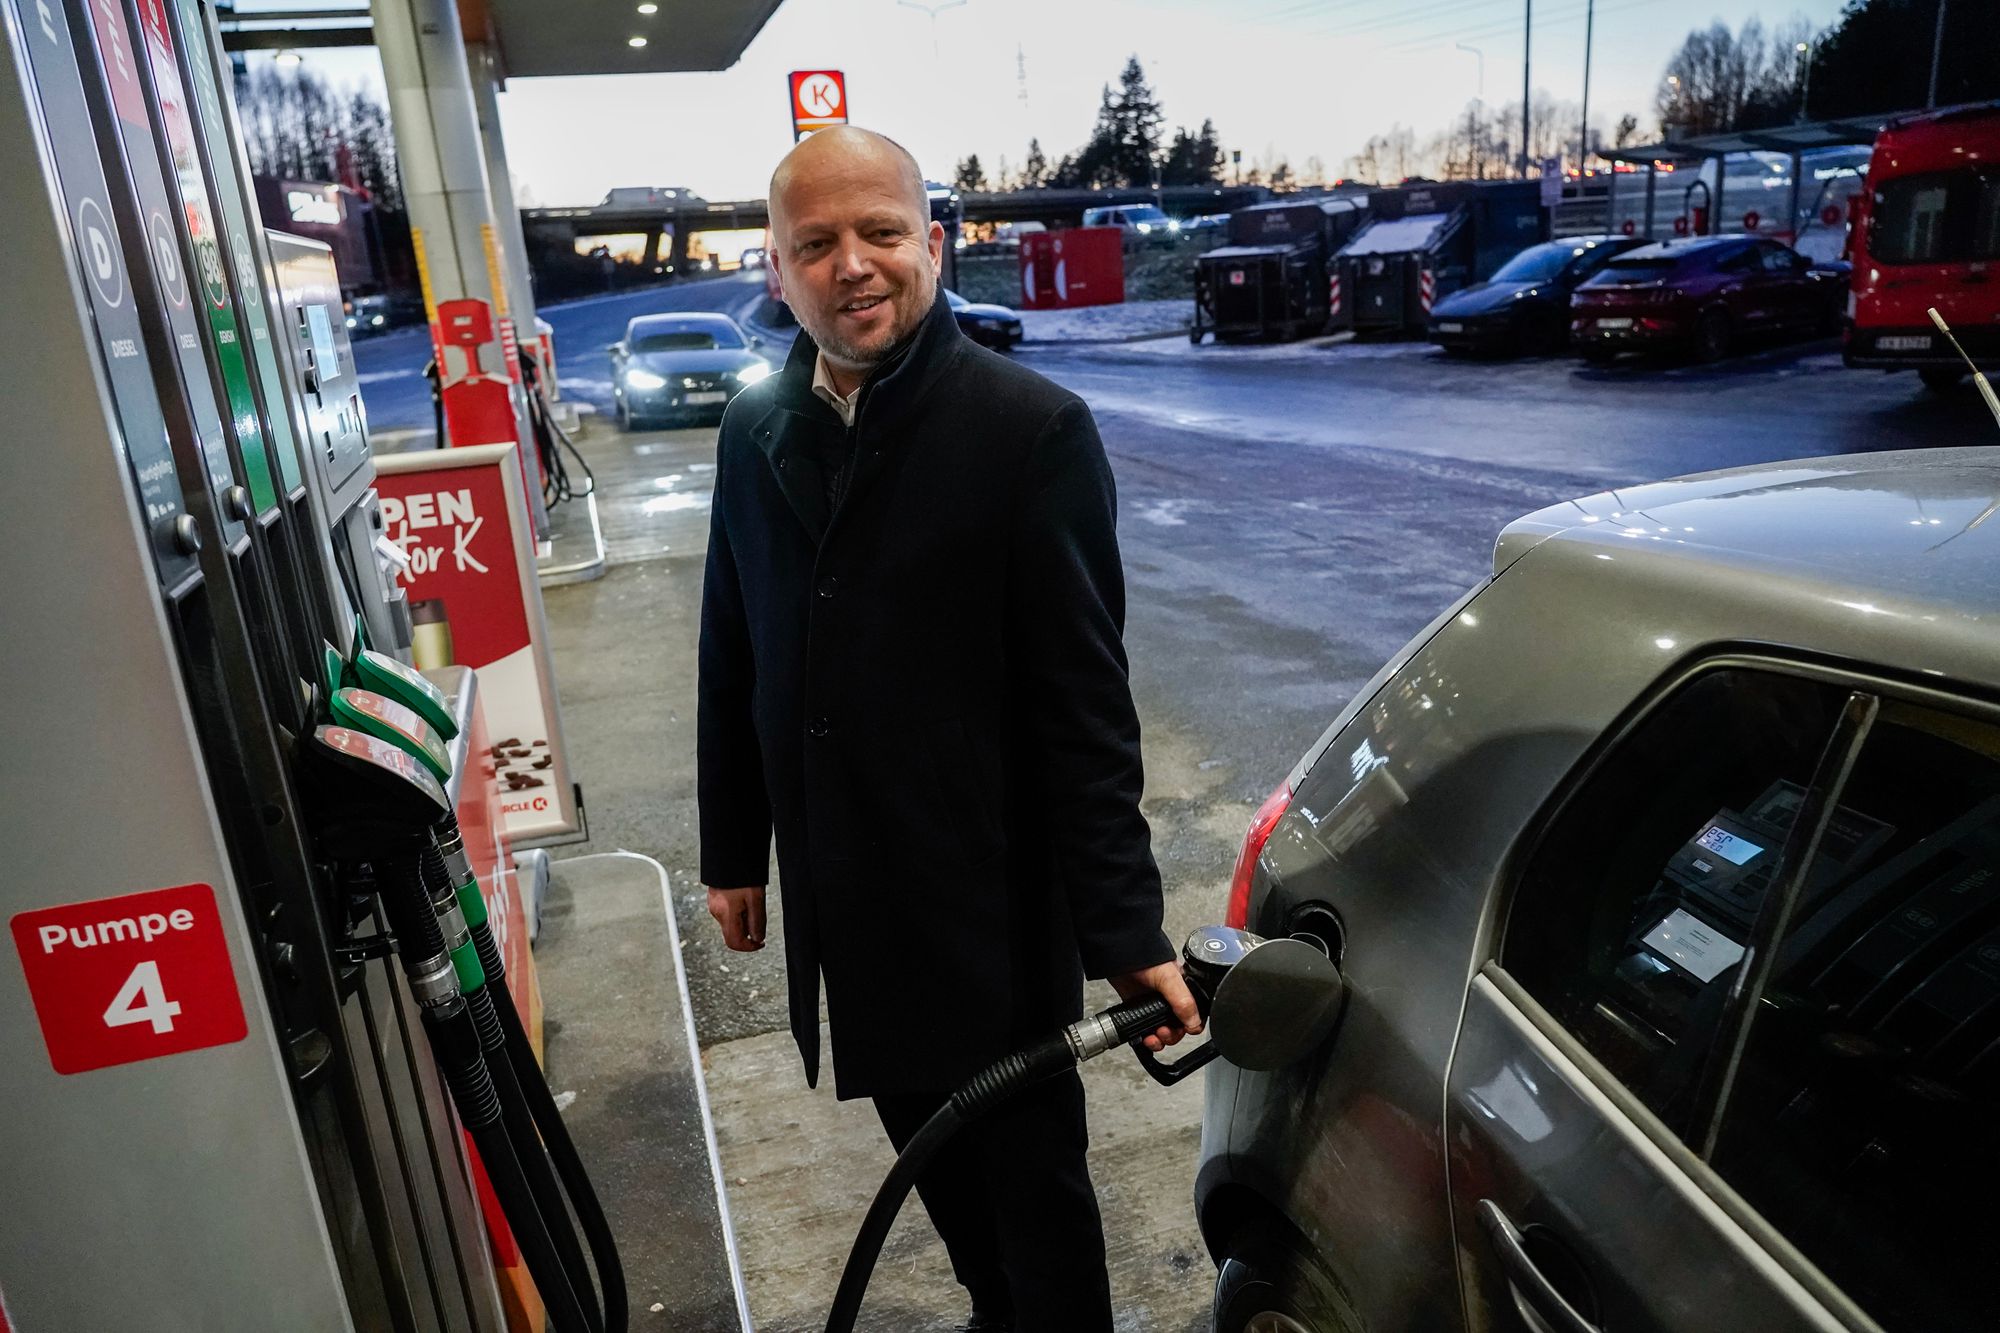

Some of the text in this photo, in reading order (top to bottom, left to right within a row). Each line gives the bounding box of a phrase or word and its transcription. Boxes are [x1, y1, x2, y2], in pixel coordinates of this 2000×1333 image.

[88, 227, 112, 279] D
[158, 237, 176, 281] D
[201, 245, 221, 284] 98
[111, 339, 139, 358] DIESEL
[379, 489, 475, 532] PEN
[452, 516, 489, 573] K
[501, 801, 530, 814] RCLE
[39, 908, 194, 954] Pumpe
[103, 960, 182, 1034] 4
